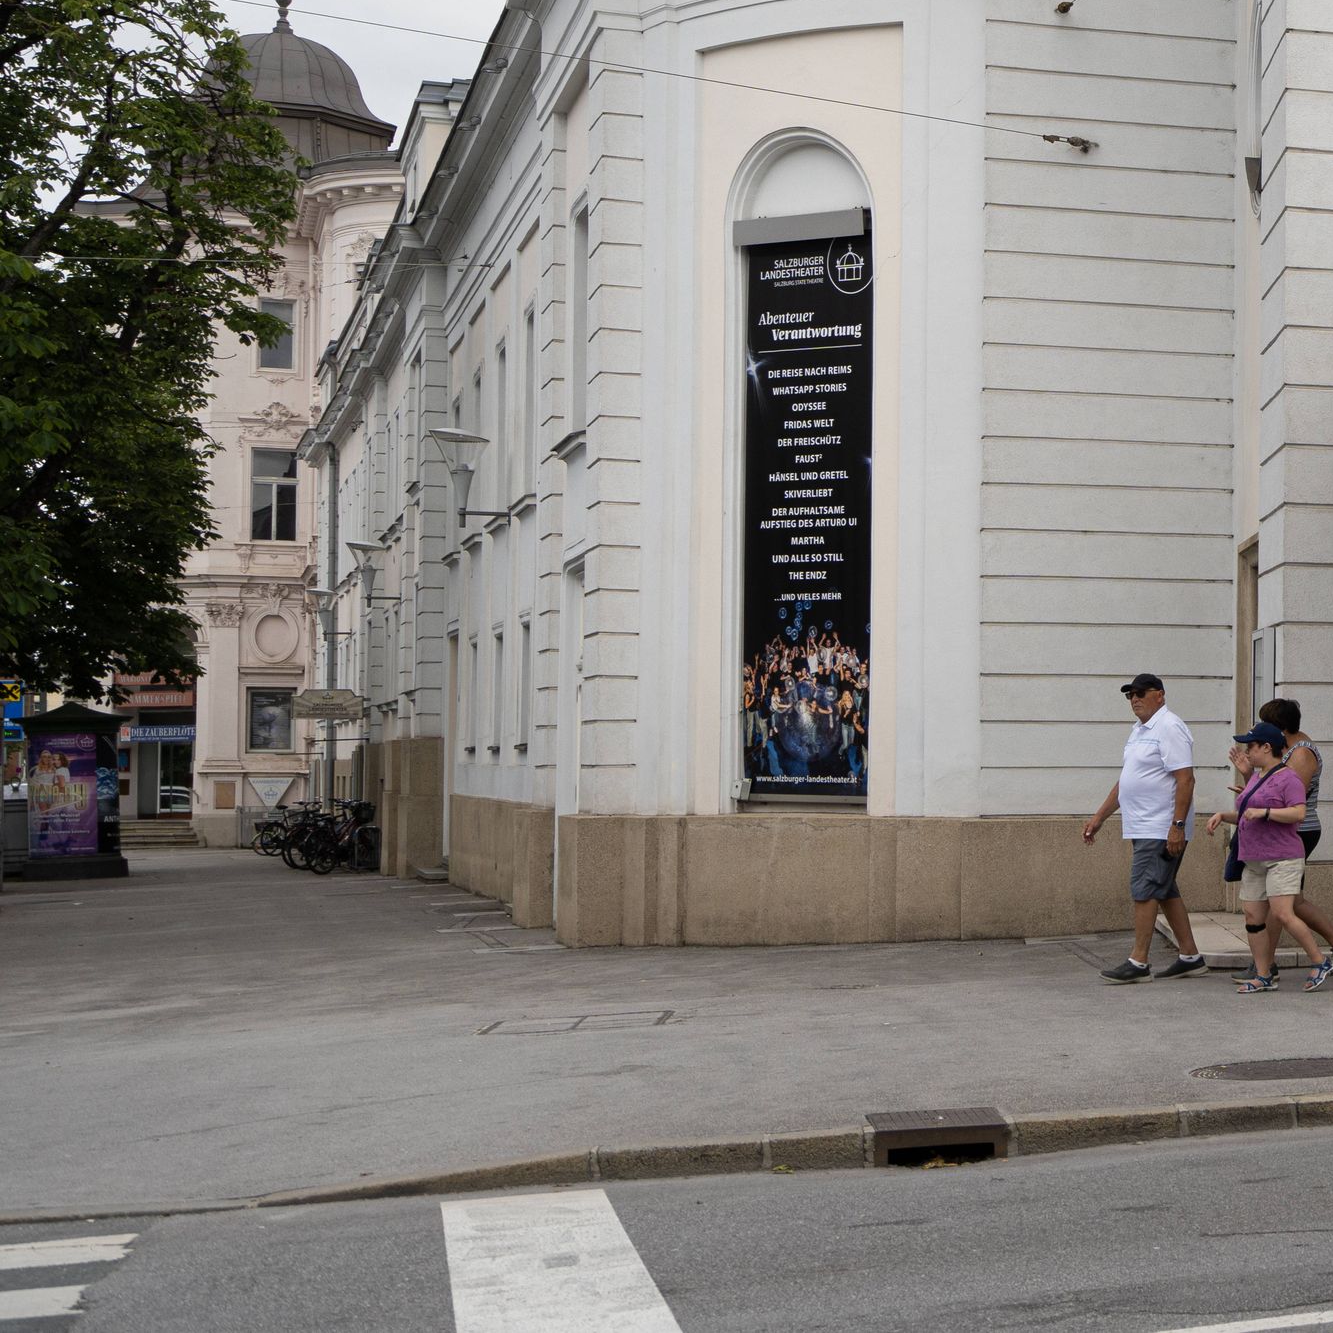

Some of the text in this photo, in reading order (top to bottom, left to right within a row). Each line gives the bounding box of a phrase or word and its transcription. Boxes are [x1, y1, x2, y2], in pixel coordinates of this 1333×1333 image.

[774, 256, 824, 269] SALZBURGER
[760, 266, 824, 280] LANDESTHEATER
[774, 279, 795, 287] SALZBURG
[795, 278, 807, 286] STATE
[758, 311, 815, 326] Abenteuer
[771, 323, 862, 341] Verantwortung
[768, 365, 852, 379] DIE REISE NACH REIMS
[772, 383, 847, 396] WHATSAPP STORIES
[791, 401, 827, 412] ODYSSEE
[784, 418, 834, 429] FRIDAS WELT
[777, 435, 841, 447] DER FREISCHÜTZ
[769, 470, 849, 482] HÄNSEL UND GRETEL
[784, 488, 833, 499] SKIVERLIEBT
[772, 506, 845, 517] DER AUFHALTSAME
[760, 517, 857, 529] AUFSTIEG DES ARTURO UI
[790, 536, 825, 545] MARTHA
[772, 553, 844, 563] UND ALLE SO STILL
[788, 570, 827, 580] THE ENDZ
[797, 592, 820, 601] VIELES
[821, 592, 842, 600] MEHR
[131, 725, 196, 737] DIE ZAUBERFLÖTE
[756, 774, 858, 785] www.salzburger-landestheater.at
